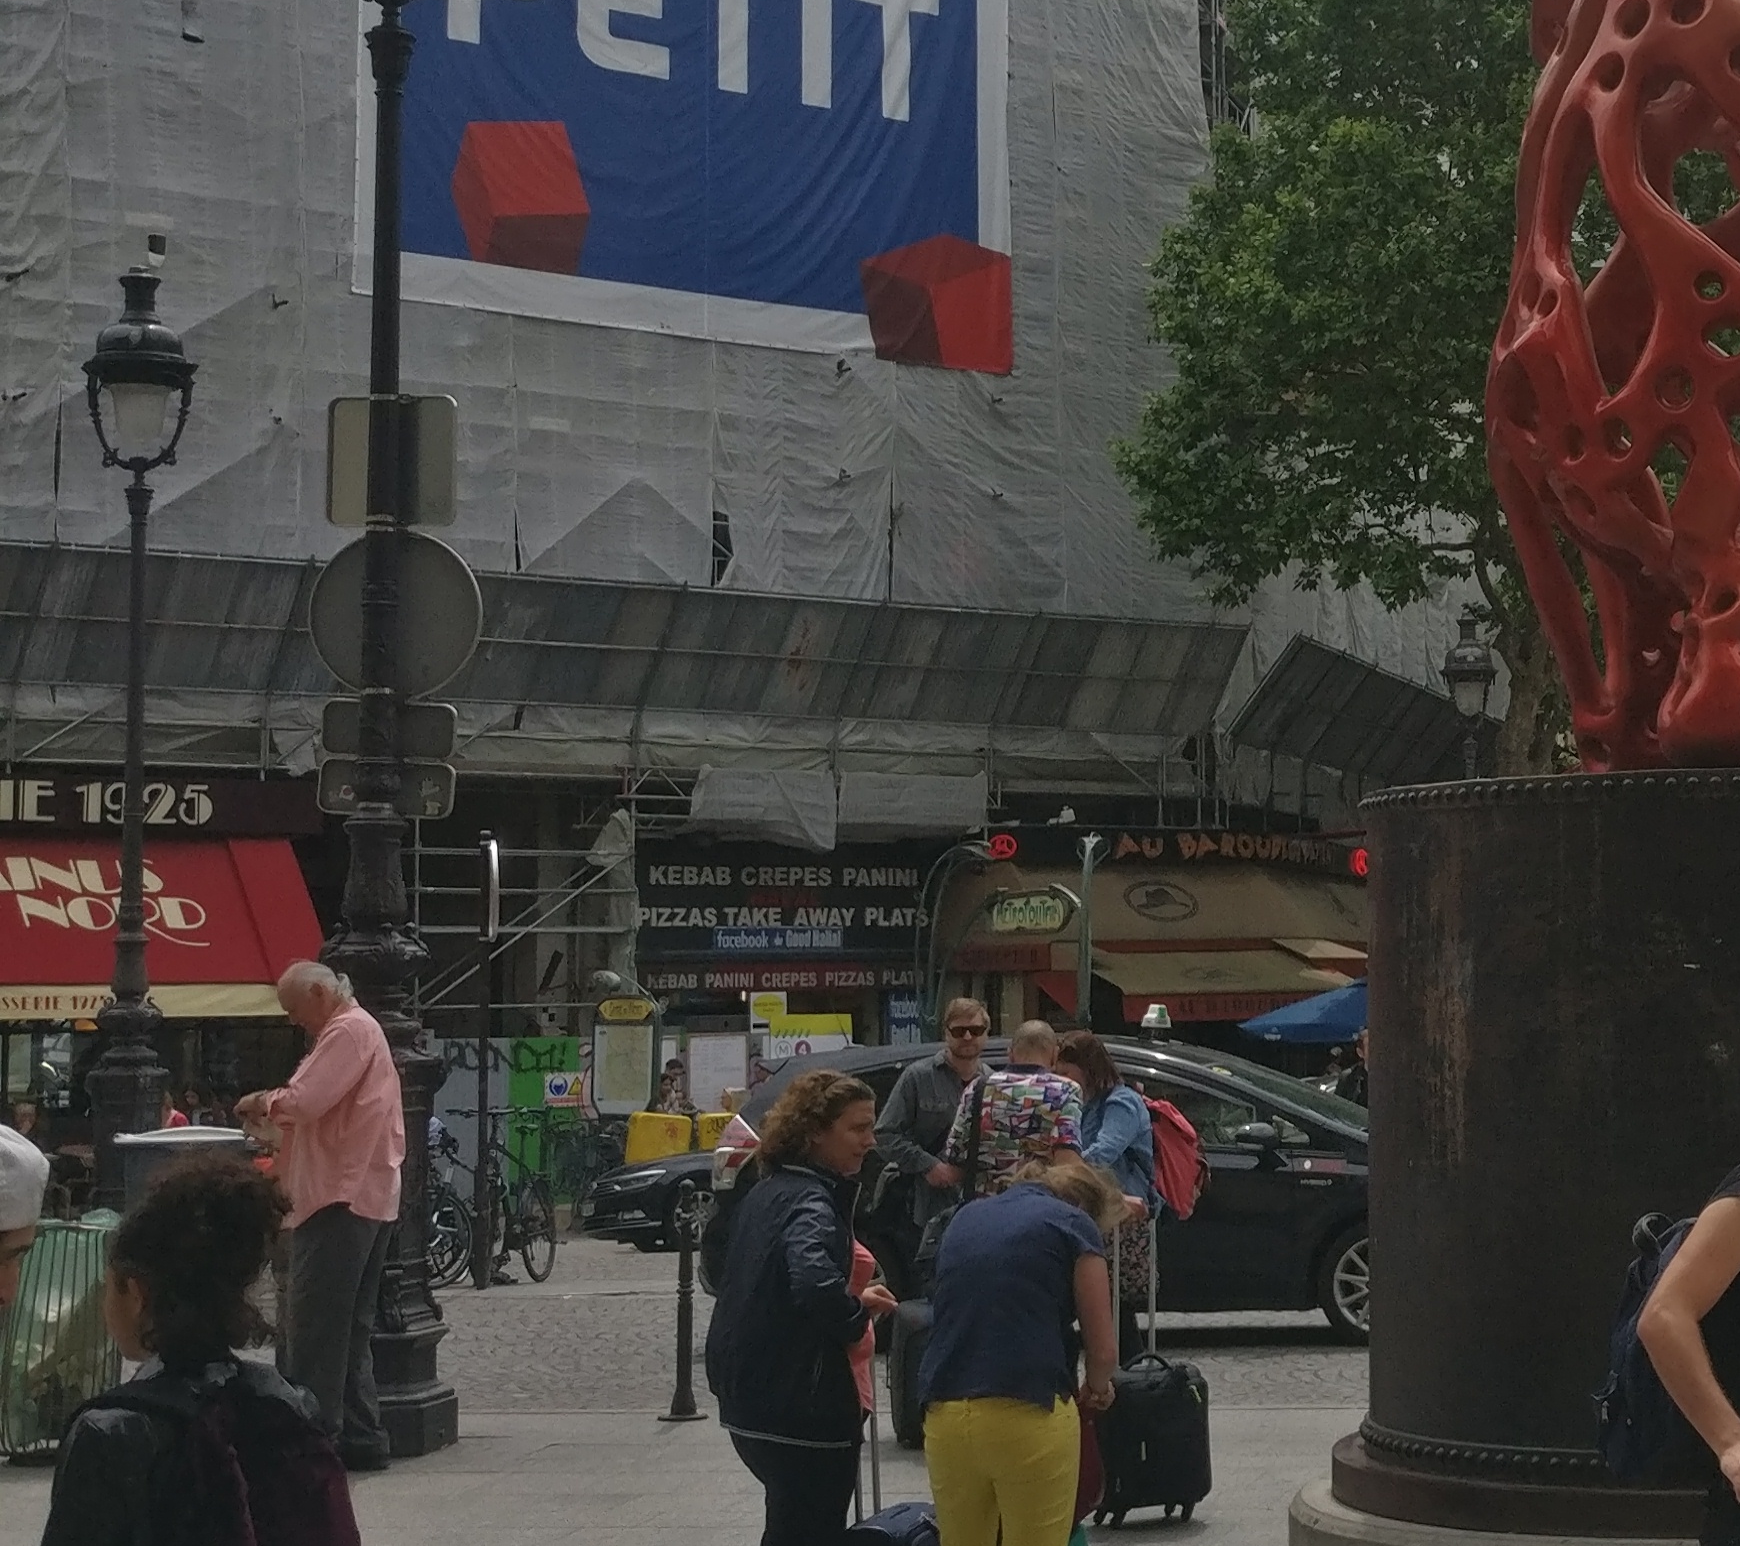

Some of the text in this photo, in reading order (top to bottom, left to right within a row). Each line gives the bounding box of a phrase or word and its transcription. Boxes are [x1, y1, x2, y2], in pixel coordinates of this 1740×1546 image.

[76, 782, 213, 825] 1925
[1116, 832, 1164, 860] AU
[650, 866, 918, 887] KEBAB CREPES PANINI
[636, 907, 929, 927] PIZZAS TAKE AWAY PLATS
[717, 930, 769, 948] facebook
[647, 973, 697, 988] KEBAB
[705, 973, 754, 987] PANINI
[761, 972, 817, 987] CREPES
[825, 971, 874, 986] PIZZAS
